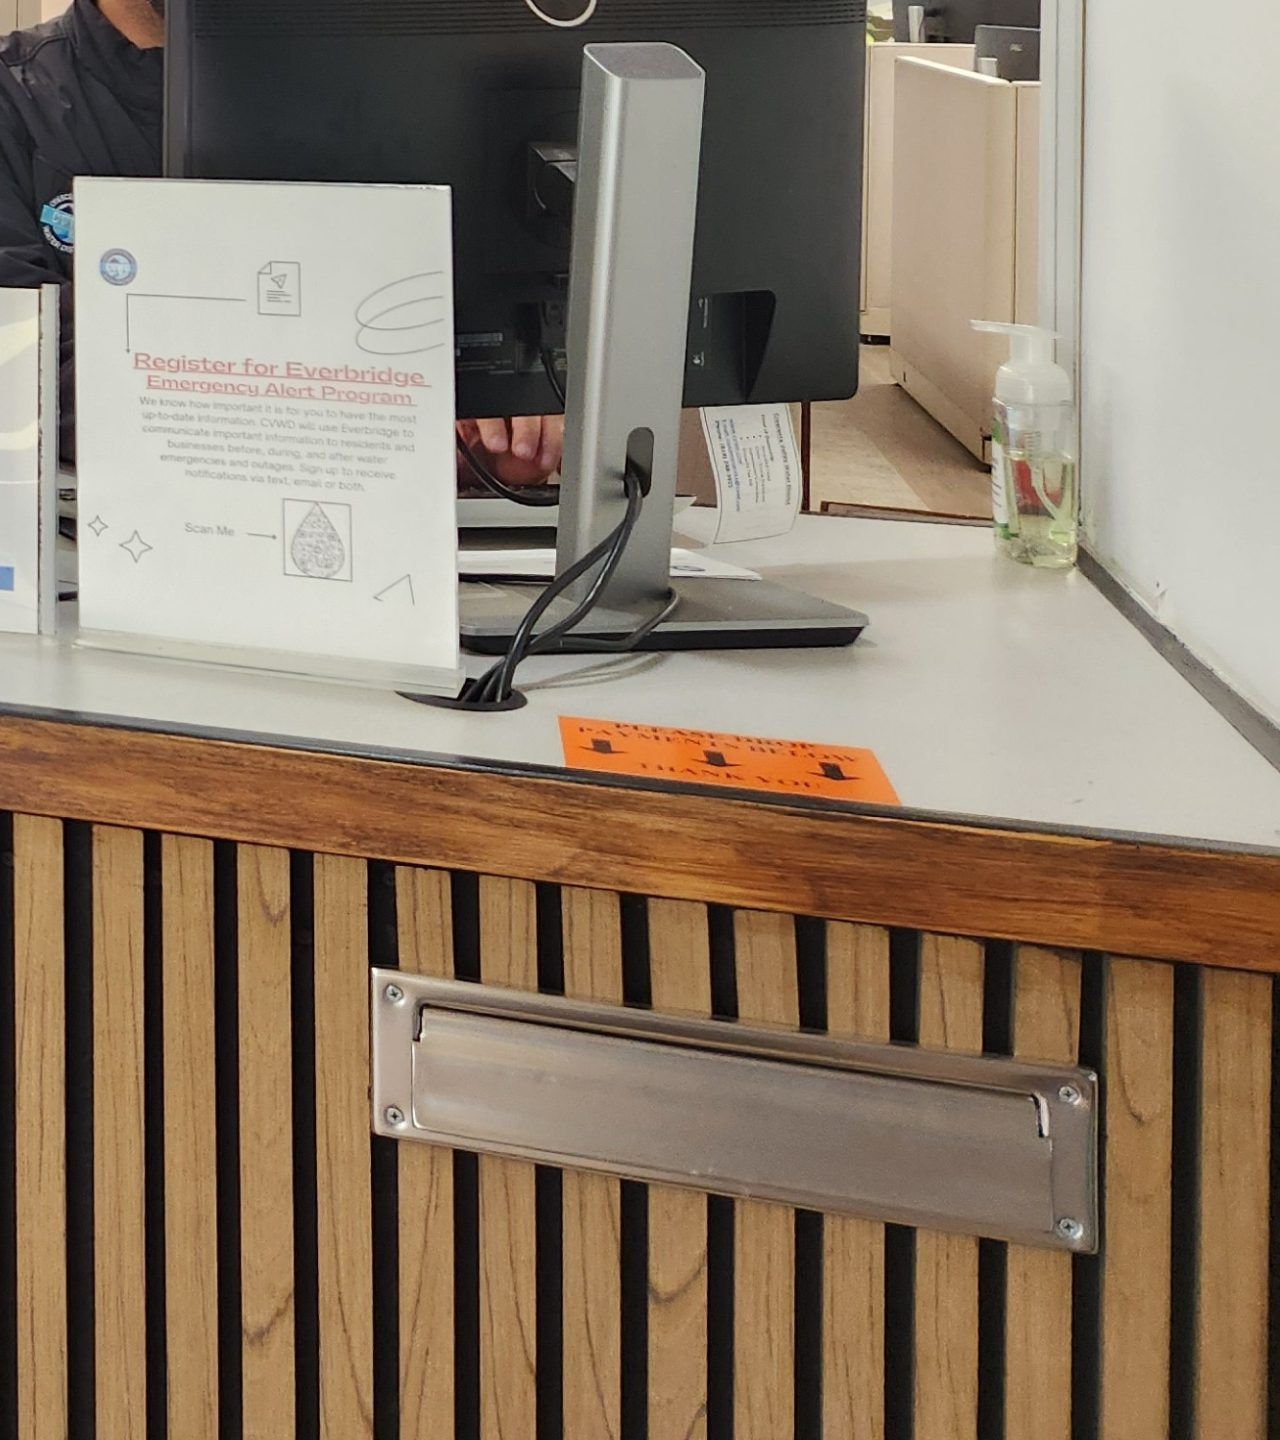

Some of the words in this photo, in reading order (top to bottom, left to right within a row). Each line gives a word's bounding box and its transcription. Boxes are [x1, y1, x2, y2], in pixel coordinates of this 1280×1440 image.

[133, 351, 237, 374] Register
[242, 357, 279, 376] for
[285, 361, 425, 387] Everbridge
[146, 374, 259, 397] Emergency
[265, 382, 316, 399] Alert
[321, 385, 413, 405] Program
[139, 396, 157, 406] We
[159, 398, 186, 407] know
[190, 399, 210, 409] how
[213, 402, 263, 413] important
[286, 406, 300, 415] for
[303, 408, 324, 418] you
[326, 409, 337, 418] to
[340, 410, 365, 420] have
[369, 412, 386, 422] the
[389, 414, 417, 424] most
[142, 411, 195, 422] up-to-date
[260, 417, 296, 429] CVWD
[318, 424, 338, 432] use
[341, 423, 400, 438] Everbridge
[403, 428, 415, 438] to
[142, 425, 211, 438] communicate
[213, 429, 263, 441] important
[265, 433, 325, 445] information
[327, 437, 338, 446] to
[340, 439, 392, 451] residents
[394, 442, 416, 452] and
[167, 439, 225, 452] businesses
[305, 450, 326, 460] and
[328, 451, 354, 461] after
[357, 454, 388, 464] water
[160, 454, 226, 466] emergencies
[229, 458, 249, 468] and
[298, 463, 323, 474] Sign
[325, 465, 339, 475] up
[341, 466, 353, 476] to
[356, 468, 396, 480] receive
[185, 469, 247, 482] notifications
[250, 474, 265, 484] via
[294, 477, 322, 488] email
[324, 480, 336, 489] or
[184, 522, 214, 534] Scan
[216, 525, 235, 536] Me
[578, 726, 739, 749] PAYMENTS
[749, 745, 856, 762] BELOW
[615, 722, 716, 739] PLEASE
[734, 735, 815, 749] DROP
[639, 763, 745, 781] THANK
[755, 775, 821, 789] YOU
